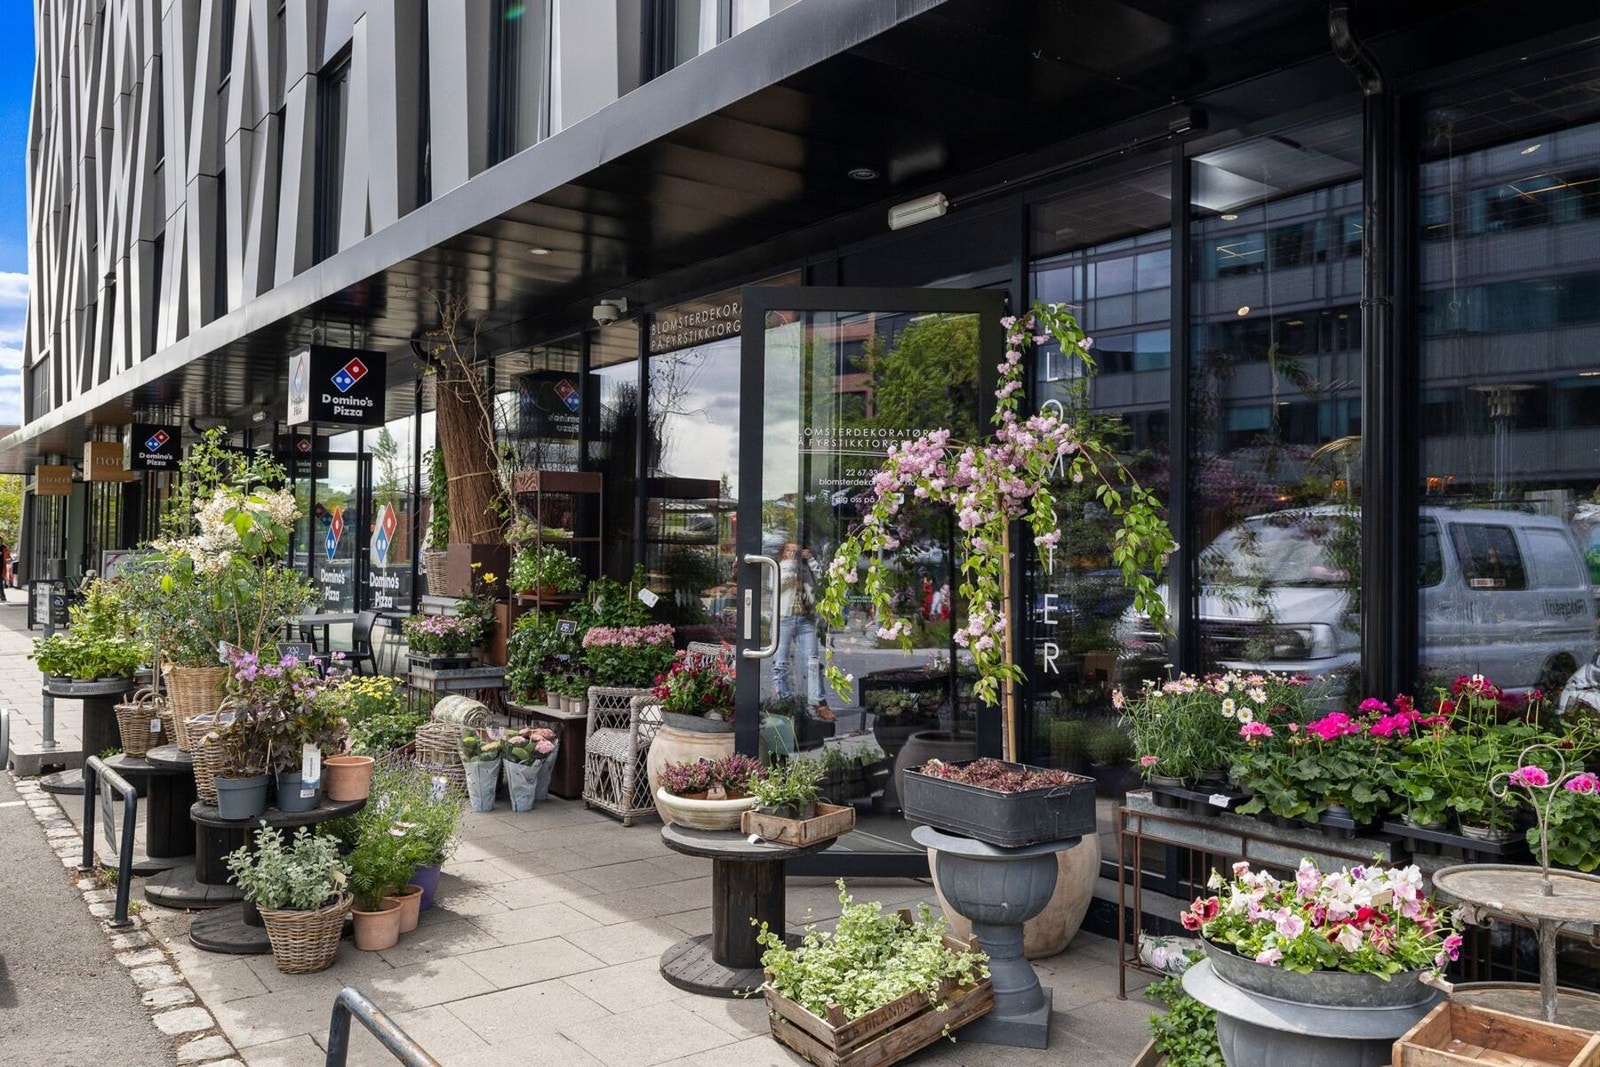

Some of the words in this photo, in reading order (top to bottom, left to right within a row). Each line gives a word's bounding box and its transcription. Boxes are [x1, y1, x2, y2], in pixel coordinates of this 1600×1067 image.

[651, 302, 743, 336] BLOMSTERDEKOR
[322, 394, 374, 407] Domino's
[333, 406, 363, 417] Pizza
[95, 456, 124, 466] nor
[138, 452, 173, 461] Domino's
[146, 459, 167, 467] Pizza
[845, 469, 856, 477] 22
[857, 469, 867, 477] 67
[864, 495, 875, 505] på
[320, 568, 346, 585] Domino's
[369, 572, 400, 589] Domino's
[325, 586, 340, 602] Pizza
[374, 591, 393, 608] Pizza
